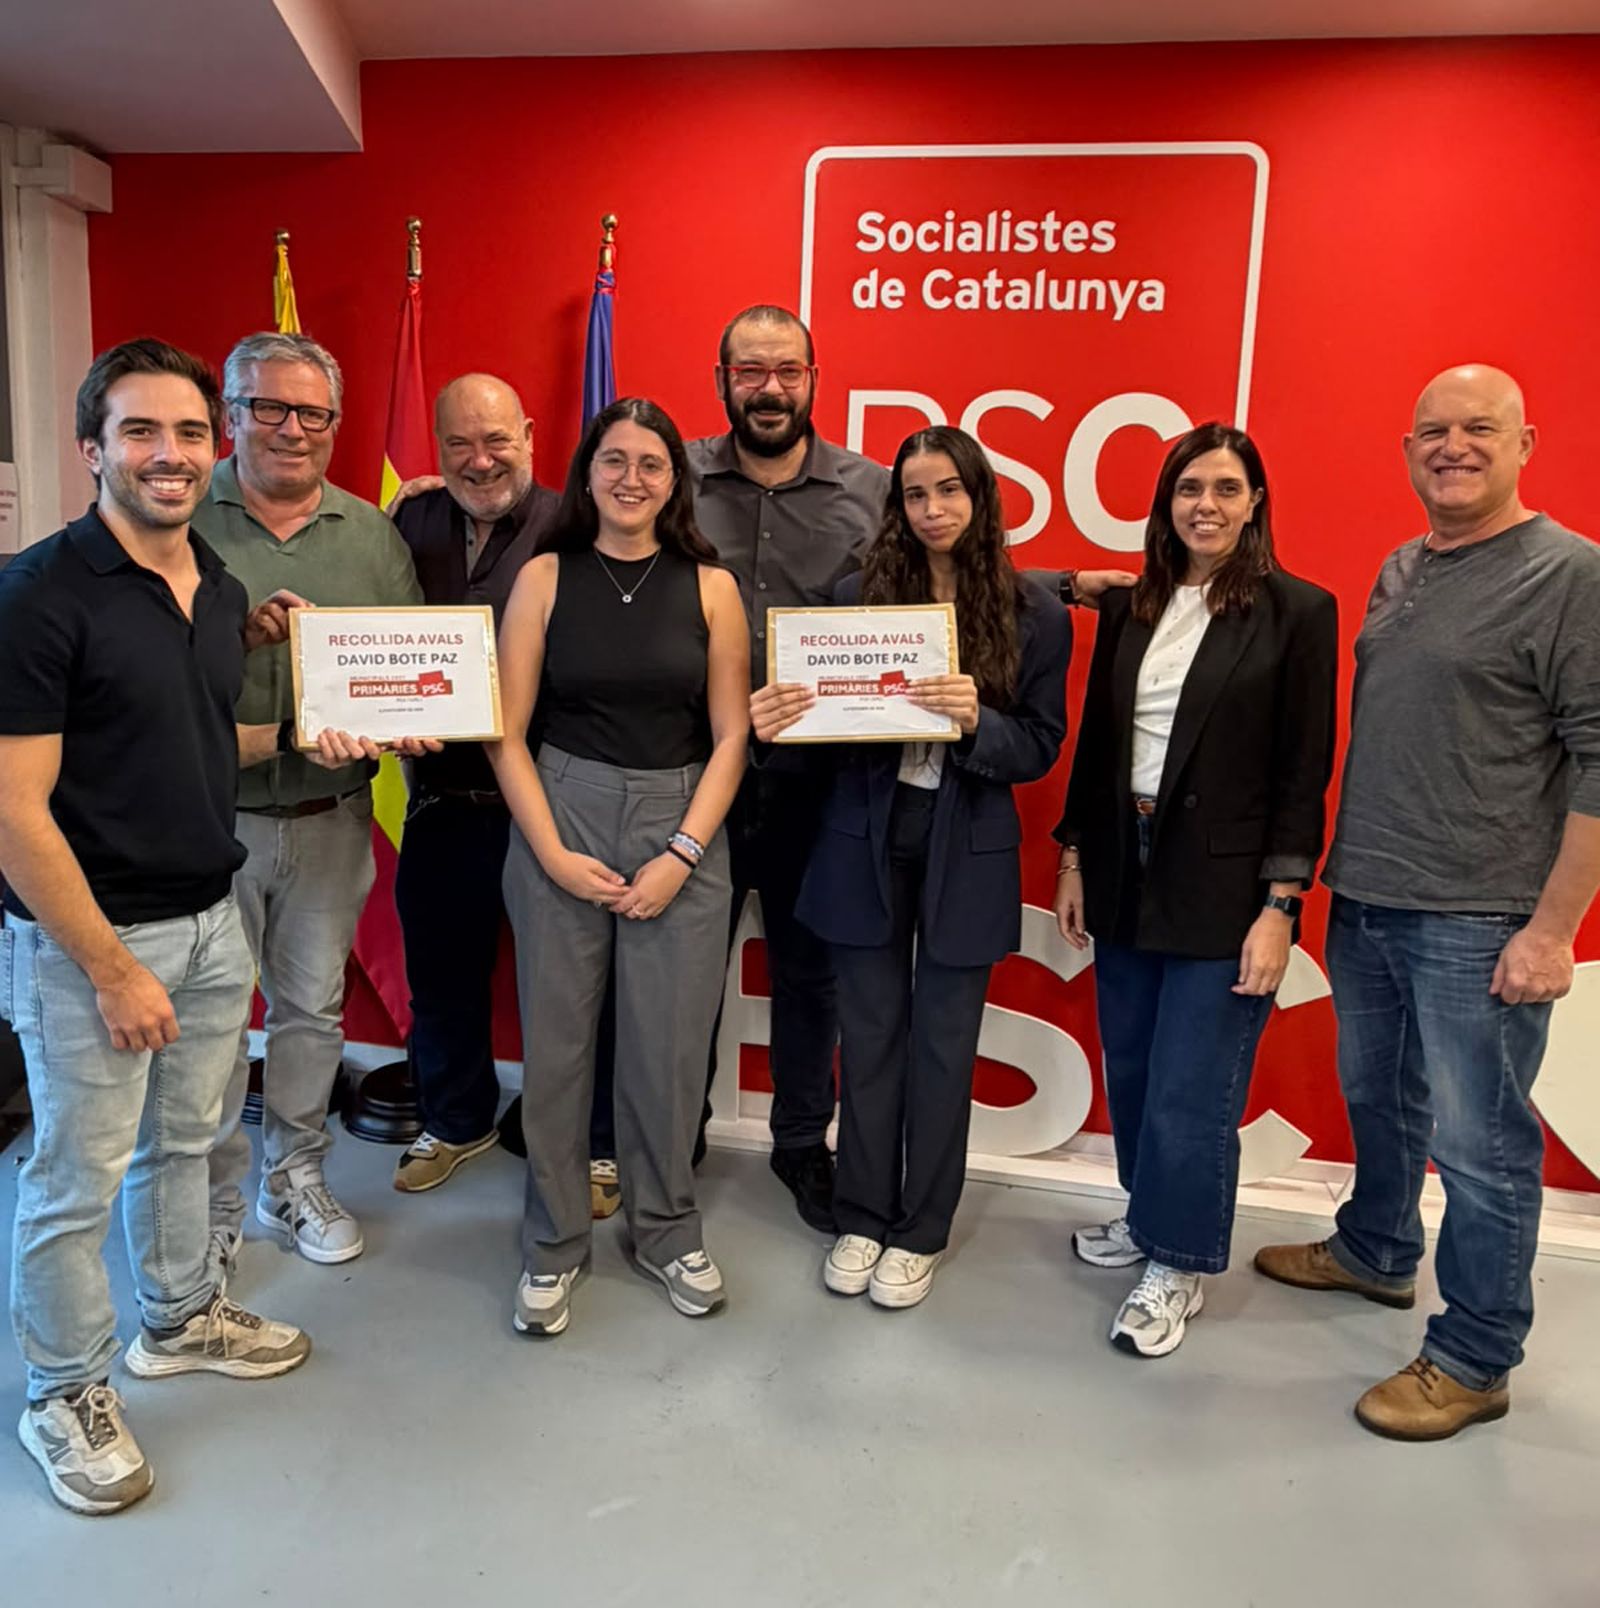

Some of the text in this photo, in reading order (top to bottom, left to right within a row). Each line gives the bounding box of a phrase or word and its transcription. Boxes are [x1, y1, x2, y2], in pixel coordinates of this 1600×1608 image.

[855, 209, 1117, 254] Socialistes
[852, 268, 1166, 321] de Catalunya
[328, 633, 464, 646] RECOLLIDA AVALS
[800, 633, 925, 646] RECOLLIDA AVALS
[337, 653, 458, 666] DAVID BOTE PAZ
[807, 653, 918, 666] DAVID BOTE PAZ
[352, 682, 446, 695] PRIMÀRIES PSC
[820, 684, 879, 694] PRIMÀRIES
